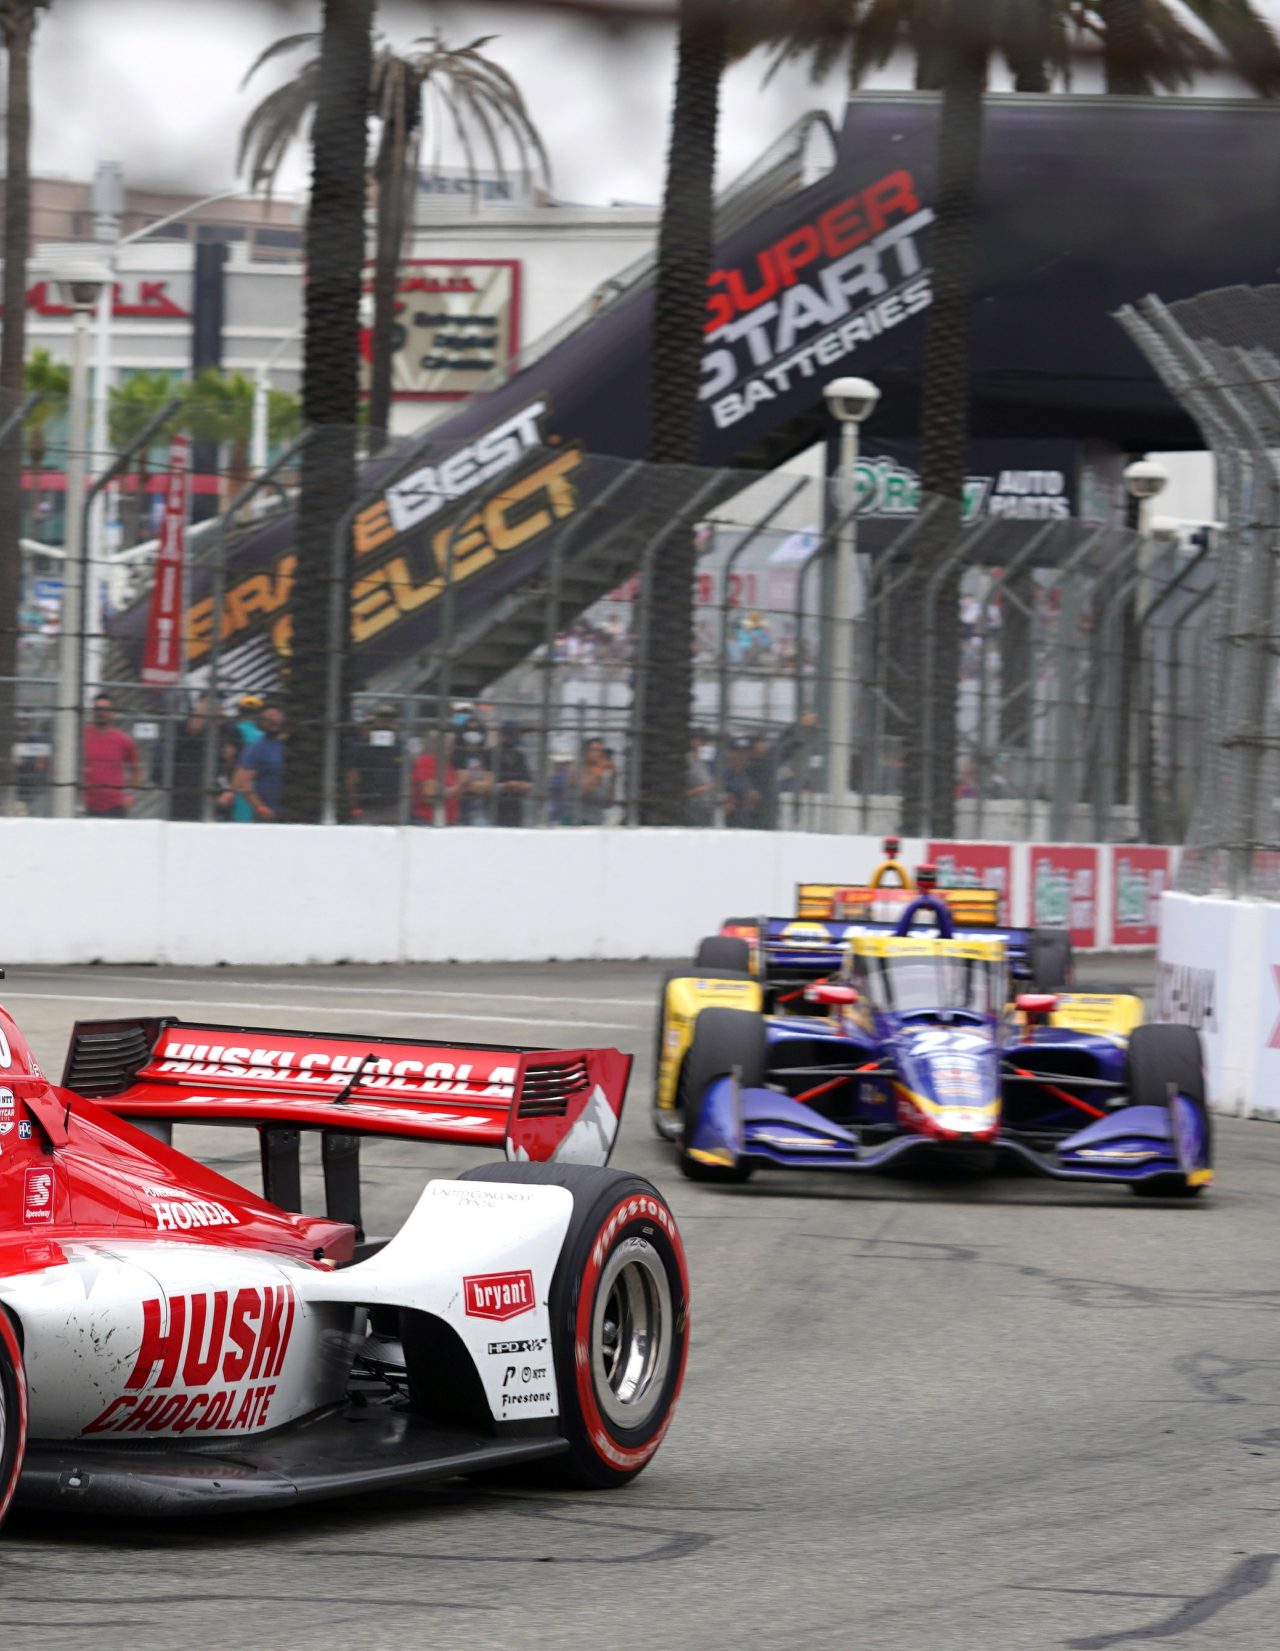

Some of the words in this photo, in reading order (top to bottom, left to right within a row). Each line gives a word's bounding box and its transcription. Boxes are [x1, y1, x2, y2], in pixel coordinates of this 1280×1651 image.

[704, 170, 920, 333] SUPER
[698, 207, 934, 400] START
[711, 278, 933, 428] BATTERIES
[156, 1042, 297, 1081] HUSKI
[1, 1096, 12, 1104] NTT
[19, 1122, 32, 1137] PPG
[25, 1209, 51, 1219] Speedway
[150, 1201, 240, 1231] HONDA
[474, 1279, 528, 1310] bryant
[123, 1284, 296, 1389] HUSKI
[488, 1342, 520, 1354] HPD
[532, 1368, 547, 1380] NTT
[81, 1384, 277, 1436] CHOCOLATE
[501, 1391, 552, 1408] Firestone
